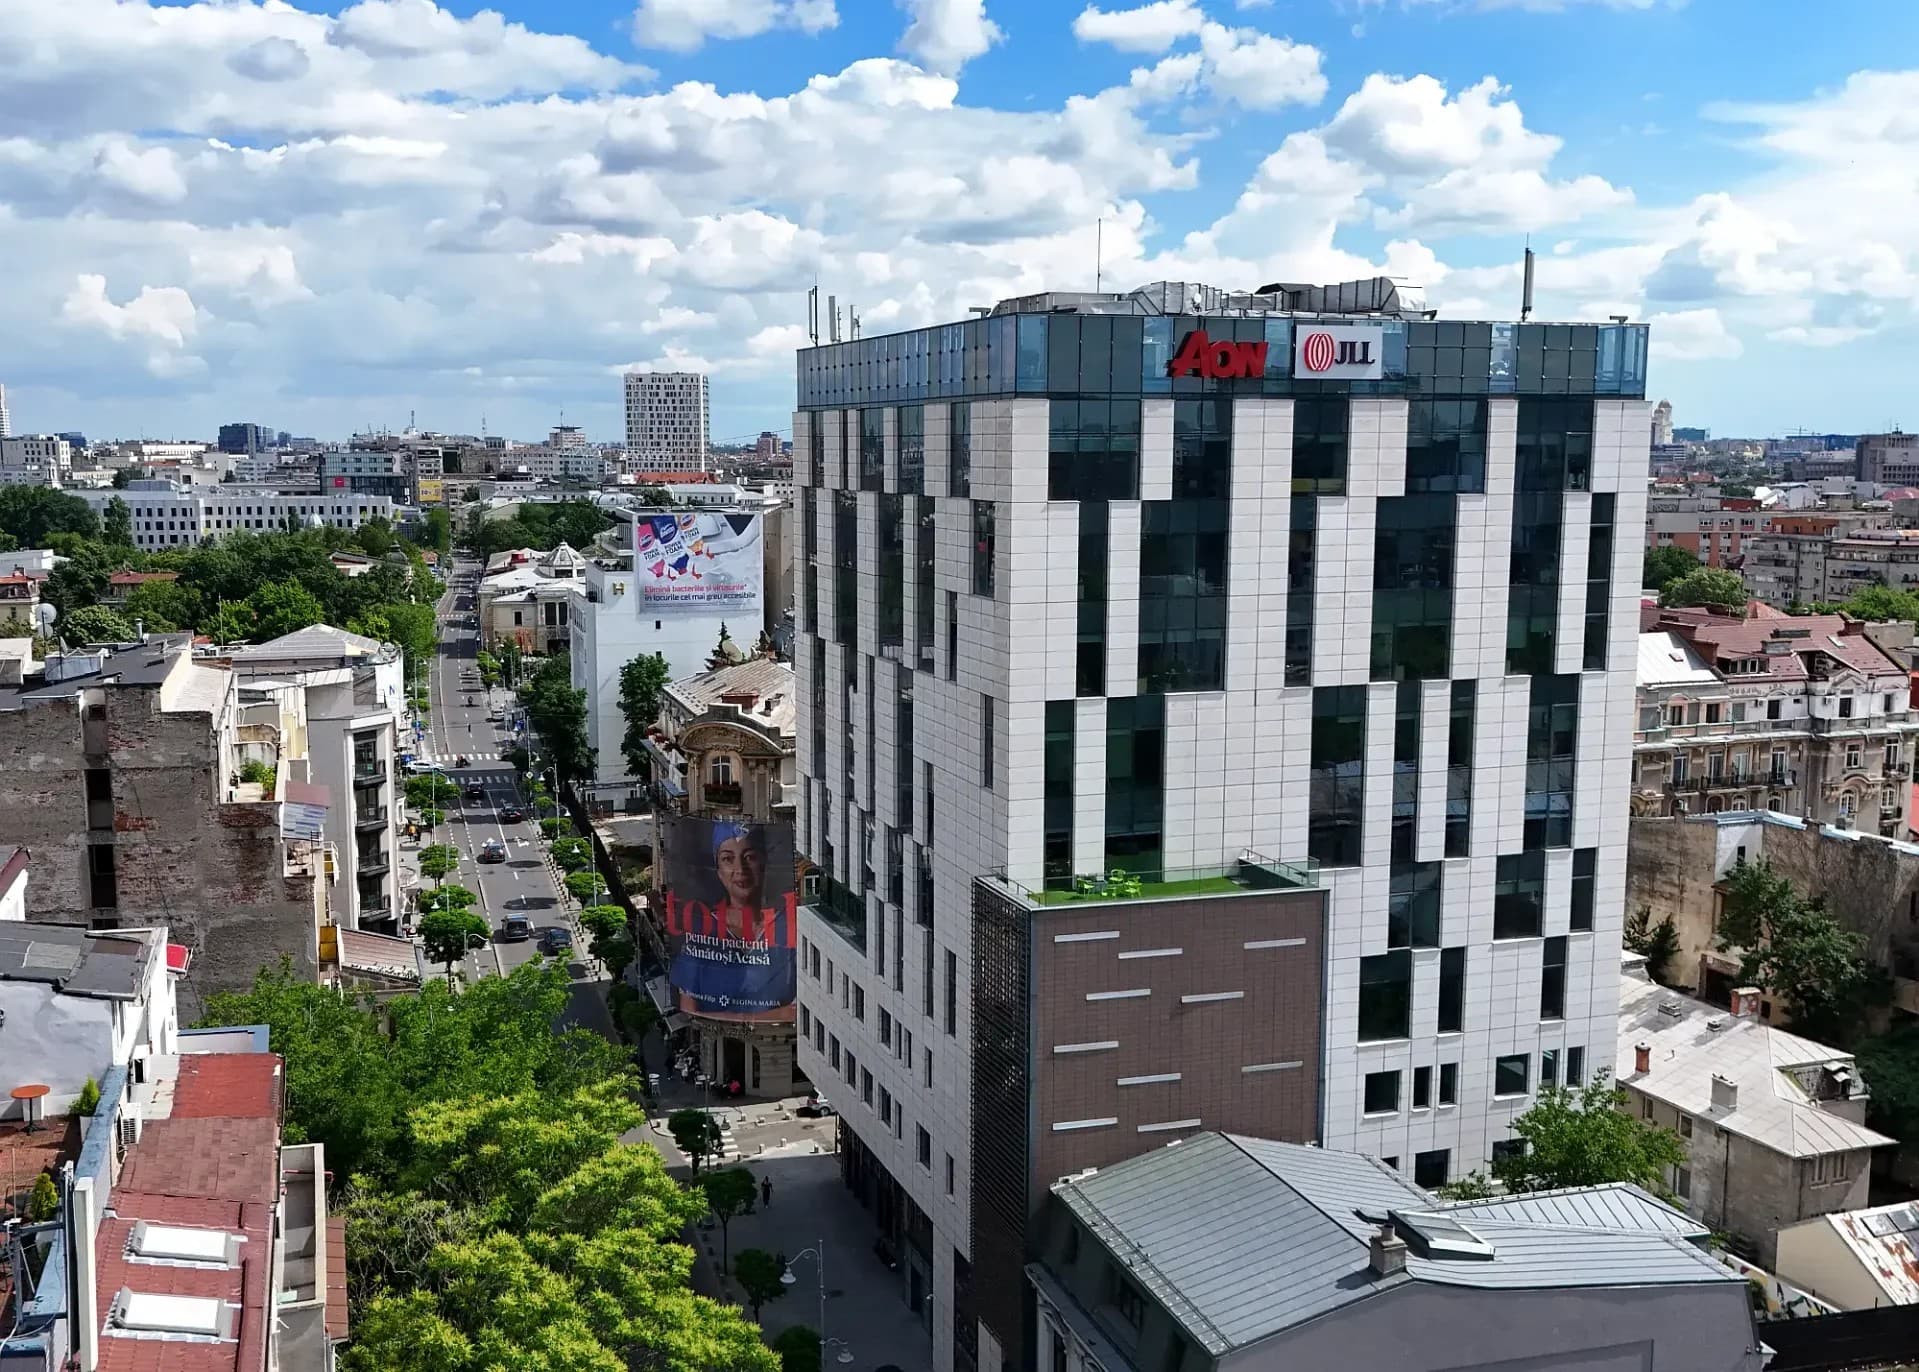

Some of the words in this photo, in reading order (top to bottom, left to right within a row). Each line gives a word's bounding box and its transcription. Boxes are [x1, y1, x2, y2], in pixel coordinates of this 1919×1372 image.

[1335, 341, 1376, 364] JLL
[665, 544, 683, 555] FOAM
[653, 593, 680, 601] locurile
[680, 593, 691, 601] cel
[692, 592, 705, 600] mai
[706, 593, 722, 602] greu
[723, 591, 756, 599] accesibile
[666, 889, 797, 949] totul
[685, 932, 719, 946] pentru
[722, 937, 768, 953] pacienți
[757, 999, 781, 1007] MARIA
